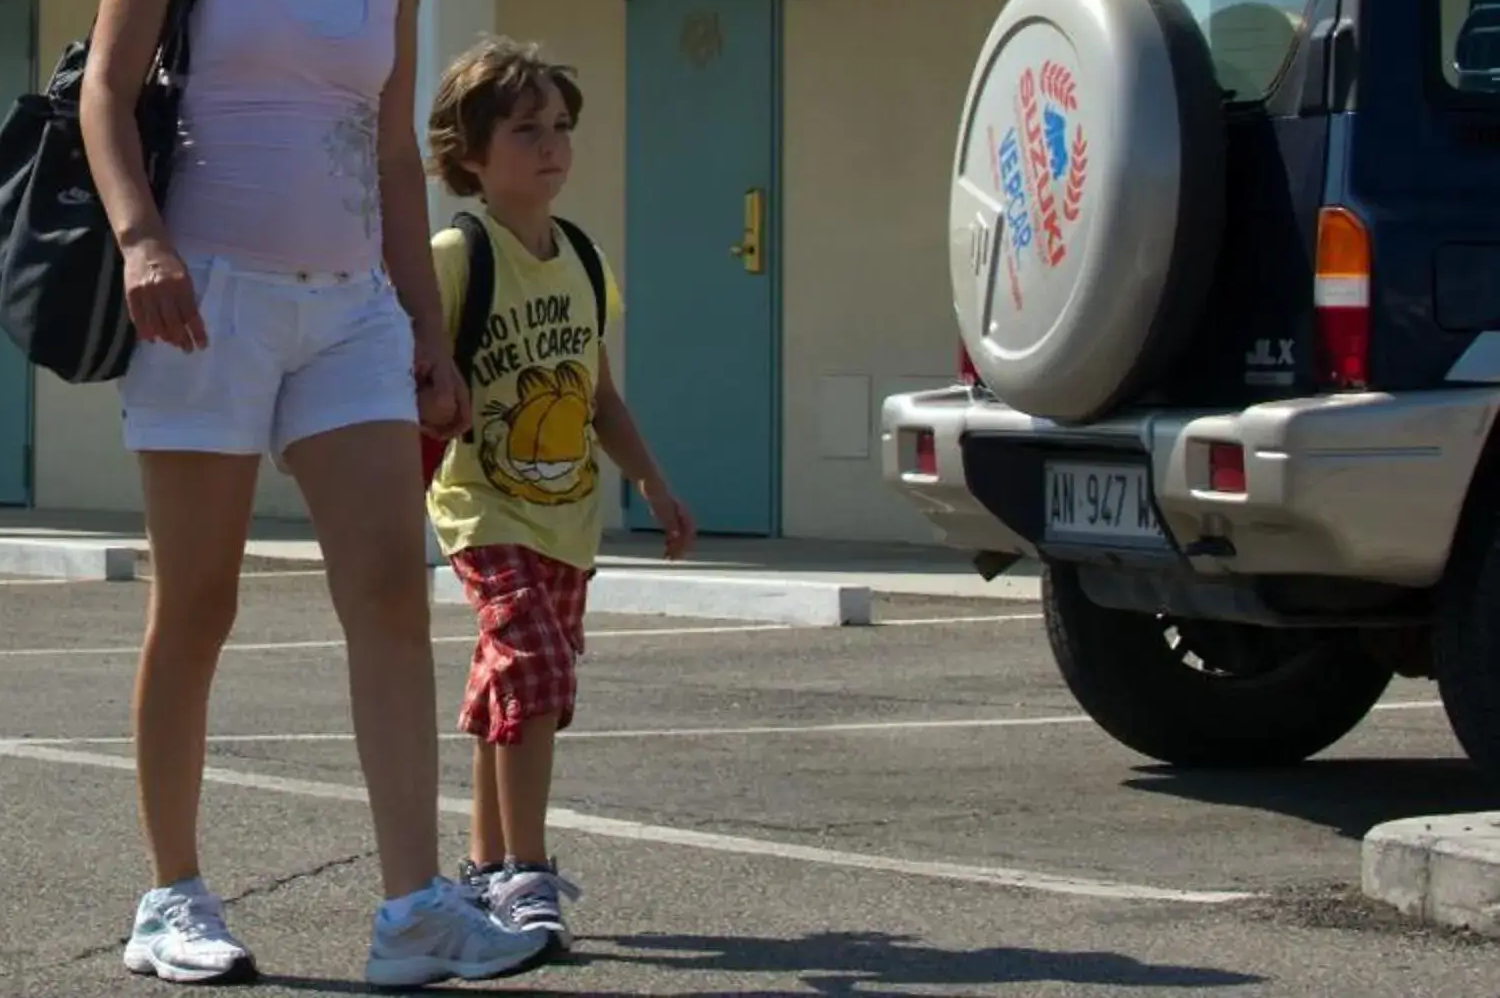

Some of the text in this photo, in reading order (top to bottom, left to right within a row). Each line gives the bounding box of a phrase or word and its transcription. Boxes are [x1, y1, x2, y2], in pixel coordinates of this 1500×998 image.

[1019, 66, 1067, 267] SUZUKI
[510, 306, 521, 336] I
[525, 294, 570, 329] LOOK
[474, 326, 592, 387] LIKE I CARE?
[1245, 338, 1295, 365] JLX
[1050, 473, 1075, 525] AN
[1086, 473, 1127, 527] 947
